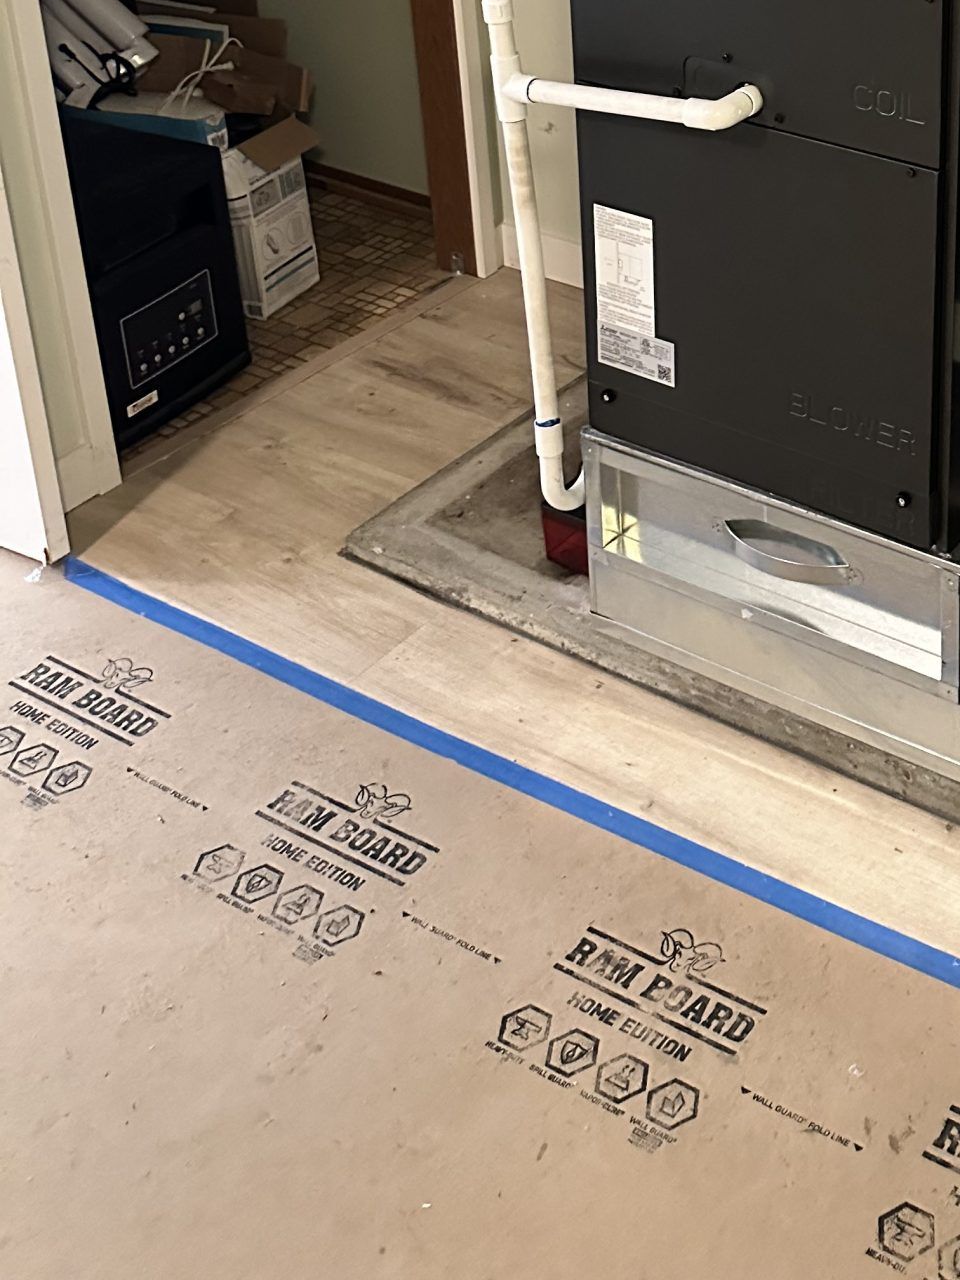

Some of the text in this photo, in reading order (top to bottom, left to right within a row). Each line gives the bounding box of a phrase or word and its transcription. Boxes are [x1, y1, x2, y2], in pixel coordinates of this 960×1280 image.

[853, 85, 926, 125] COIL
[787, 391, 918, 457] BLOWER
[9, 700, 99, 750] HOME EDITION
[20, 662, 159, 737] RAM BOARD
[260, 833, 367, 892] HOME EDITION
[266, 789, 428, 875] RAM BOARD
[455, 938, 476, 952] FOLD
[564, 936, 756, 1043] RAM BOARD
[565, 991, 693, 1062] HOME EDITION
[752, 1093, 774, 1110] WALL
[807, 1121, 831, 1137] FOLD
[830, 1132, 851, 1148] LINE
